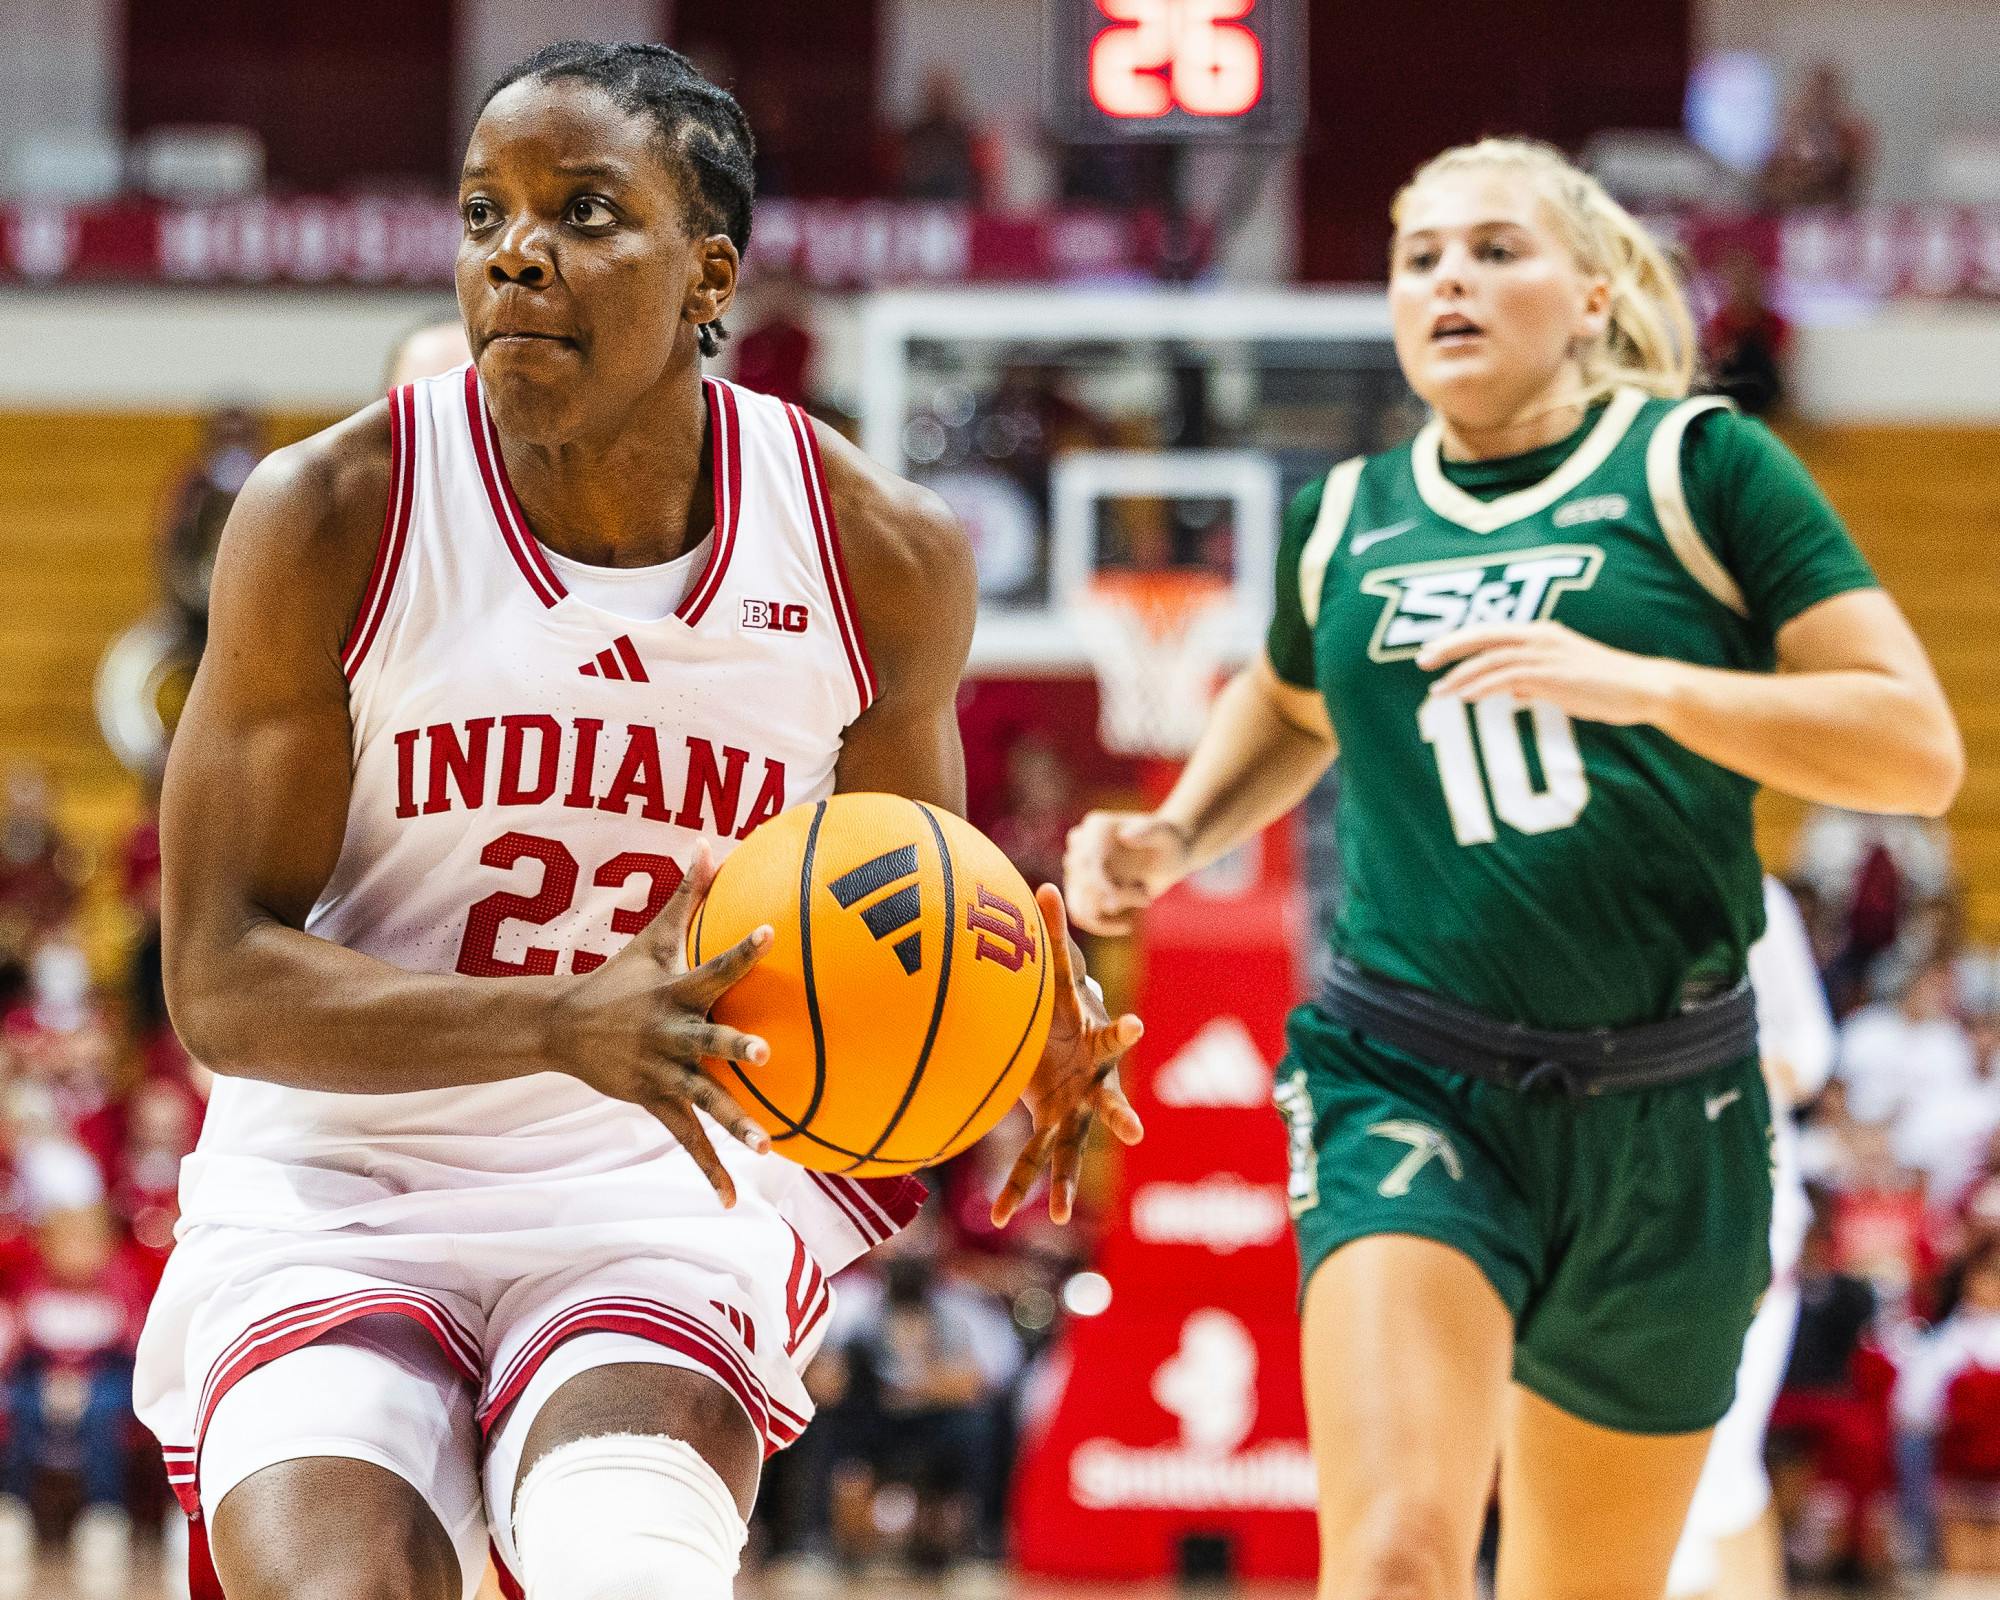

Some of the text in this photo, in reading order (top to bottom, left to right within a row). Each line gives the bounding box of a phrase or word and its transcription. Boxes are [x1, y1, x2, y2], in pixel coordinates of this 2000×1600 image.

[1380, 553, 1590, 649] S&T
[394, 714, 785, 840] INDIANA
[1416, 690, 1591, 847] 10
